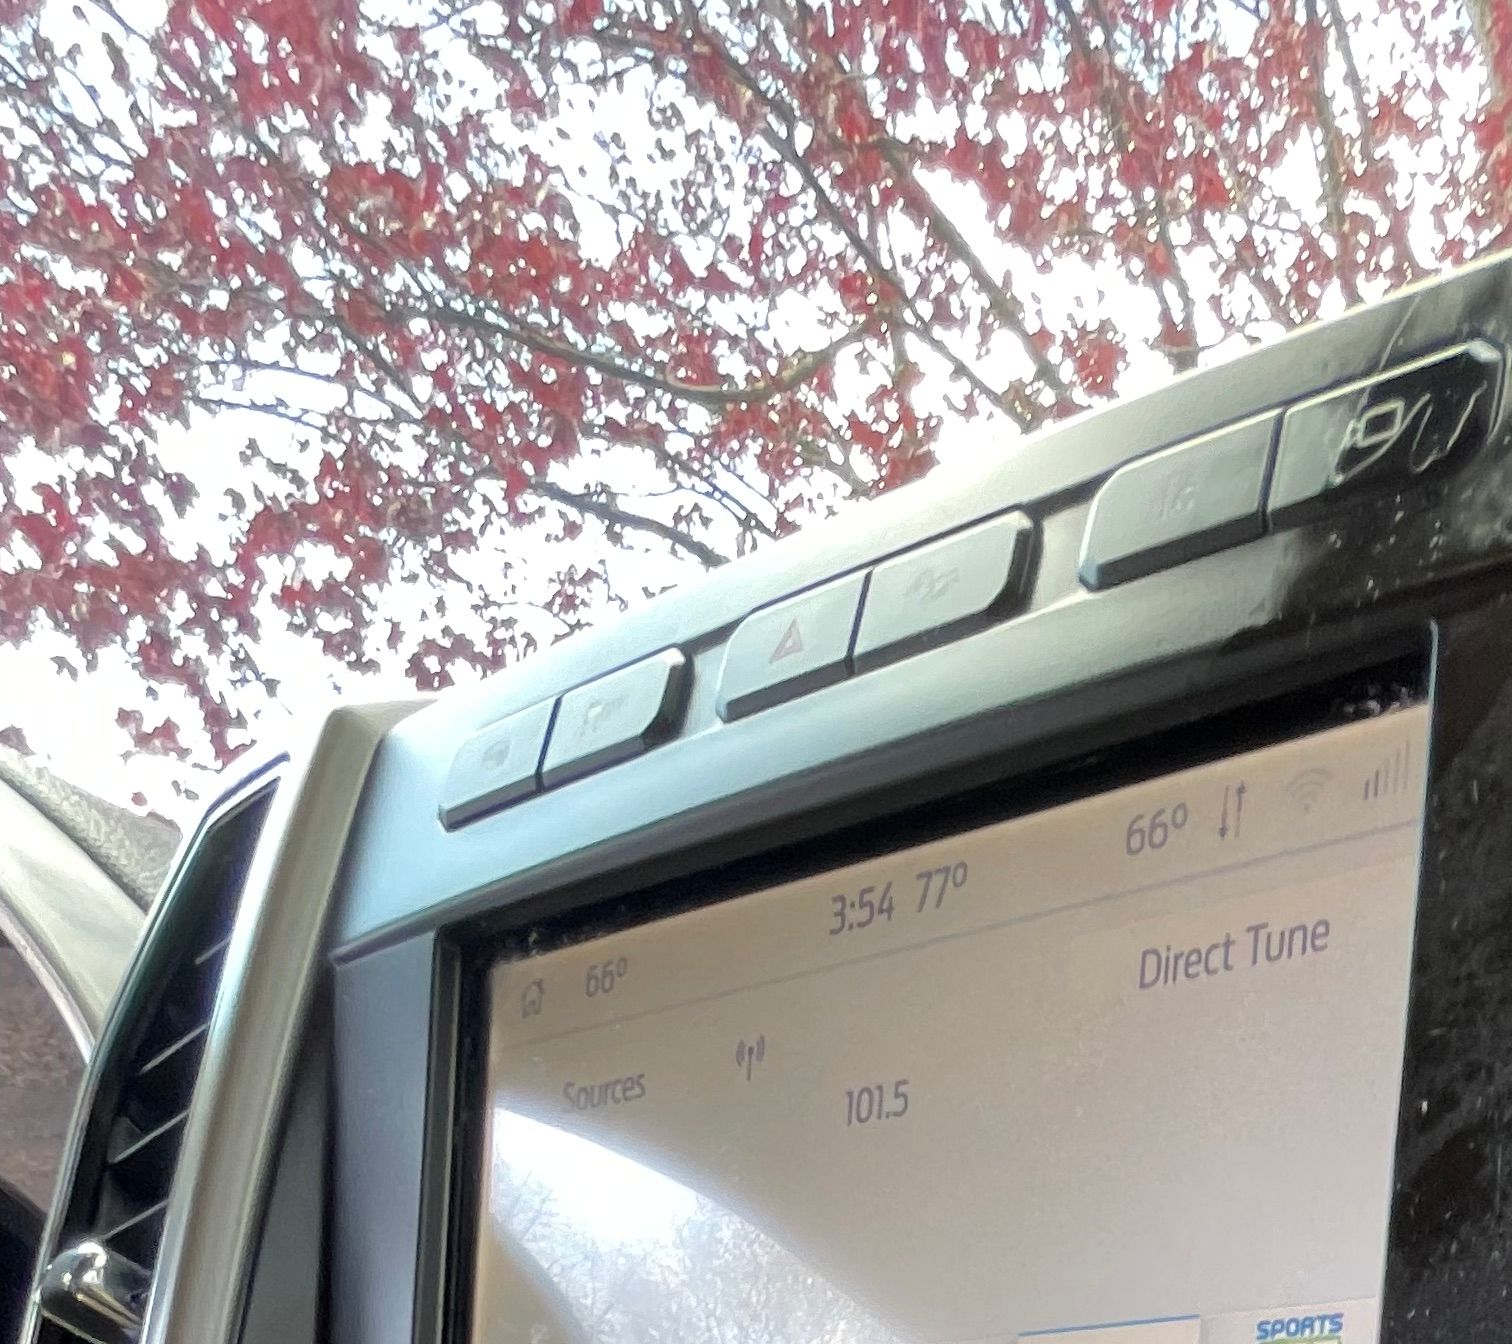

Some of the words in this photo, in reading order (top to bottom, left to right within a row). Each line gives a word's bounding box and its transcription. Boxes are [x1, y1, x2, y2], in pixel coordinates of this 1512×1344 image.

[829, 882, 895, 936] 3:54
[1139, 932, 1234, 990] Direct
[1246, 917, 1331, 967] Tune
[563, 1073, 647, 1111] Sources
[846, 1080, 909, 1126] 101.5
[1256, 1312, 1344, 1340] SPORTS
